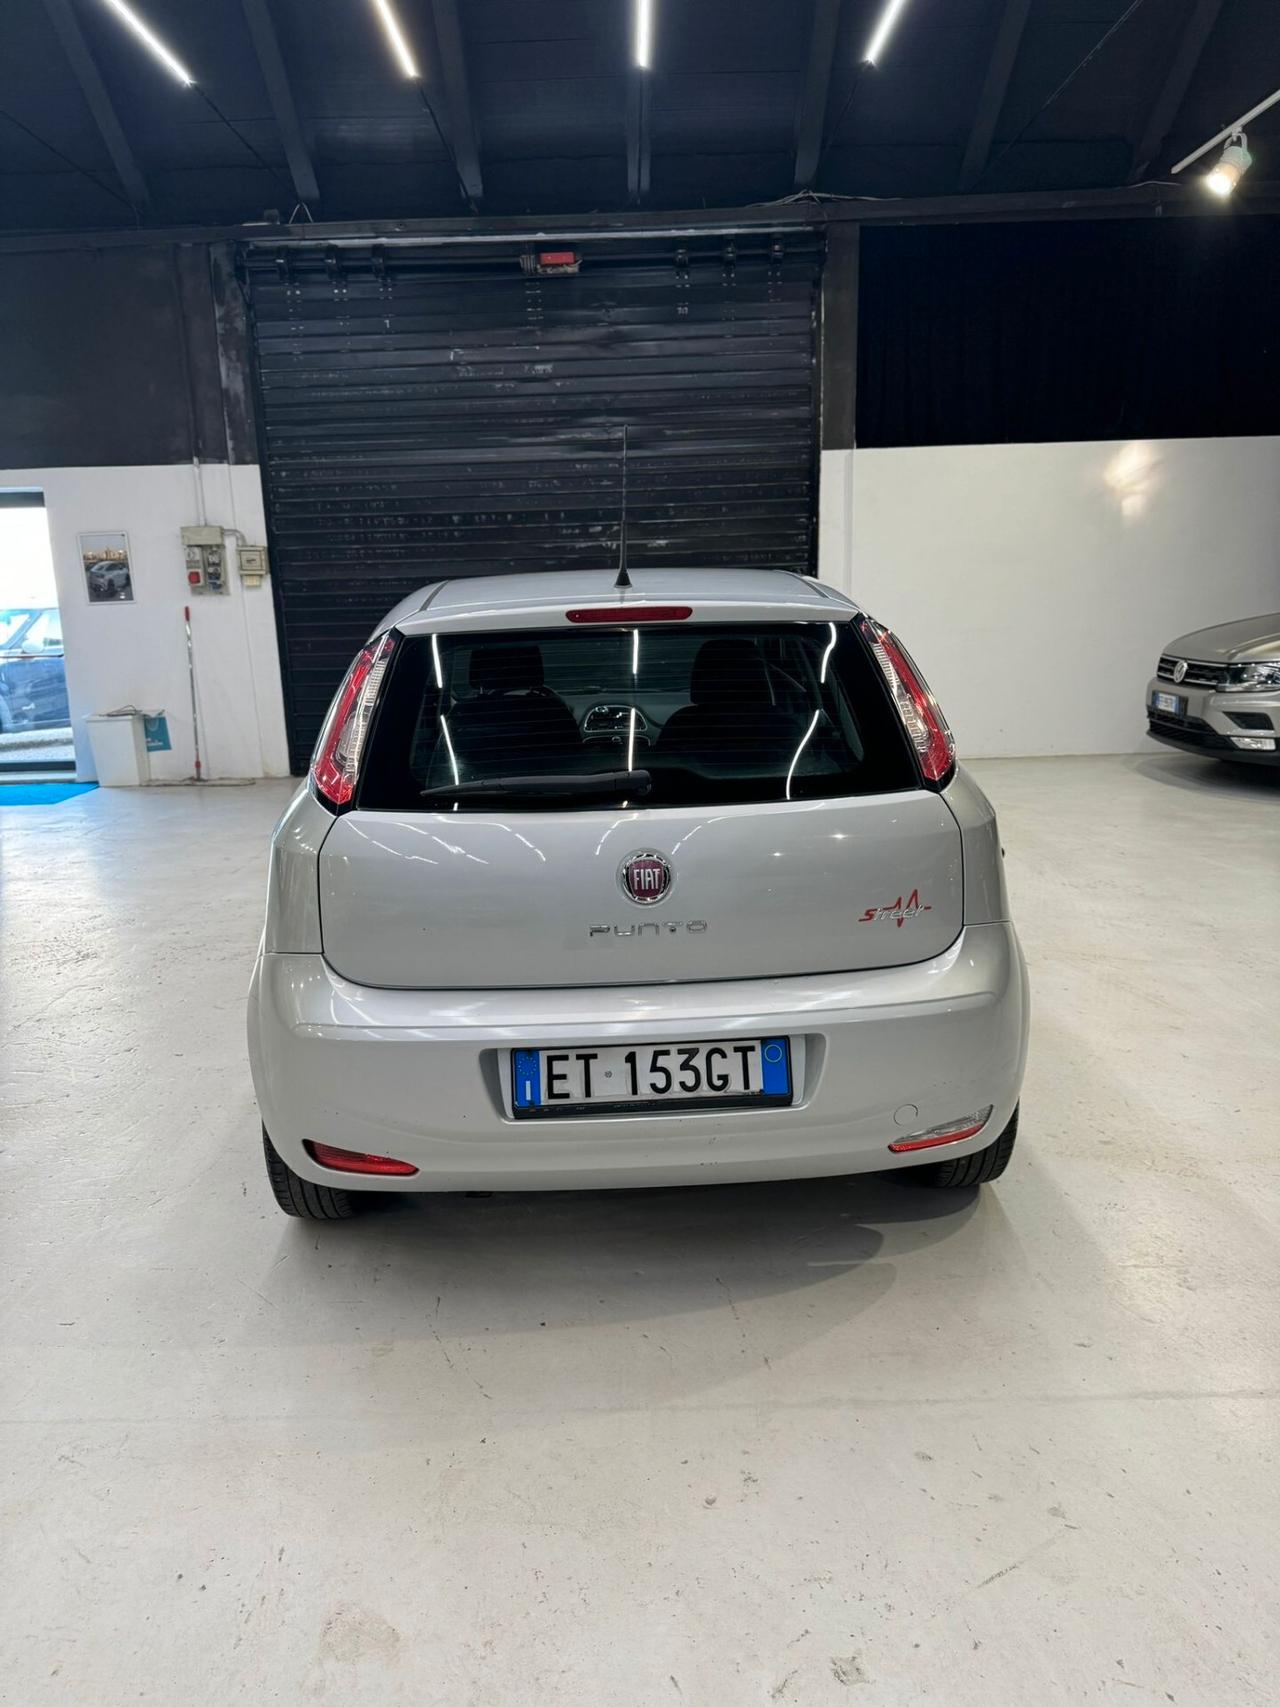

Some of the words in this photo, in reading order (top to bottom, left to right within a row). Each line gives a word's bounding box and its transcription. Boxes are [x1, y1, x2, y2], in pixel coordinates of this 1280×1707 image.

[633, 868, 660, 891] FIAT
[589, 920, 708, 938] PUNTO
[546, 1053, 598, 1100] ET
[625, 1045, 755, 1096] 153GT
